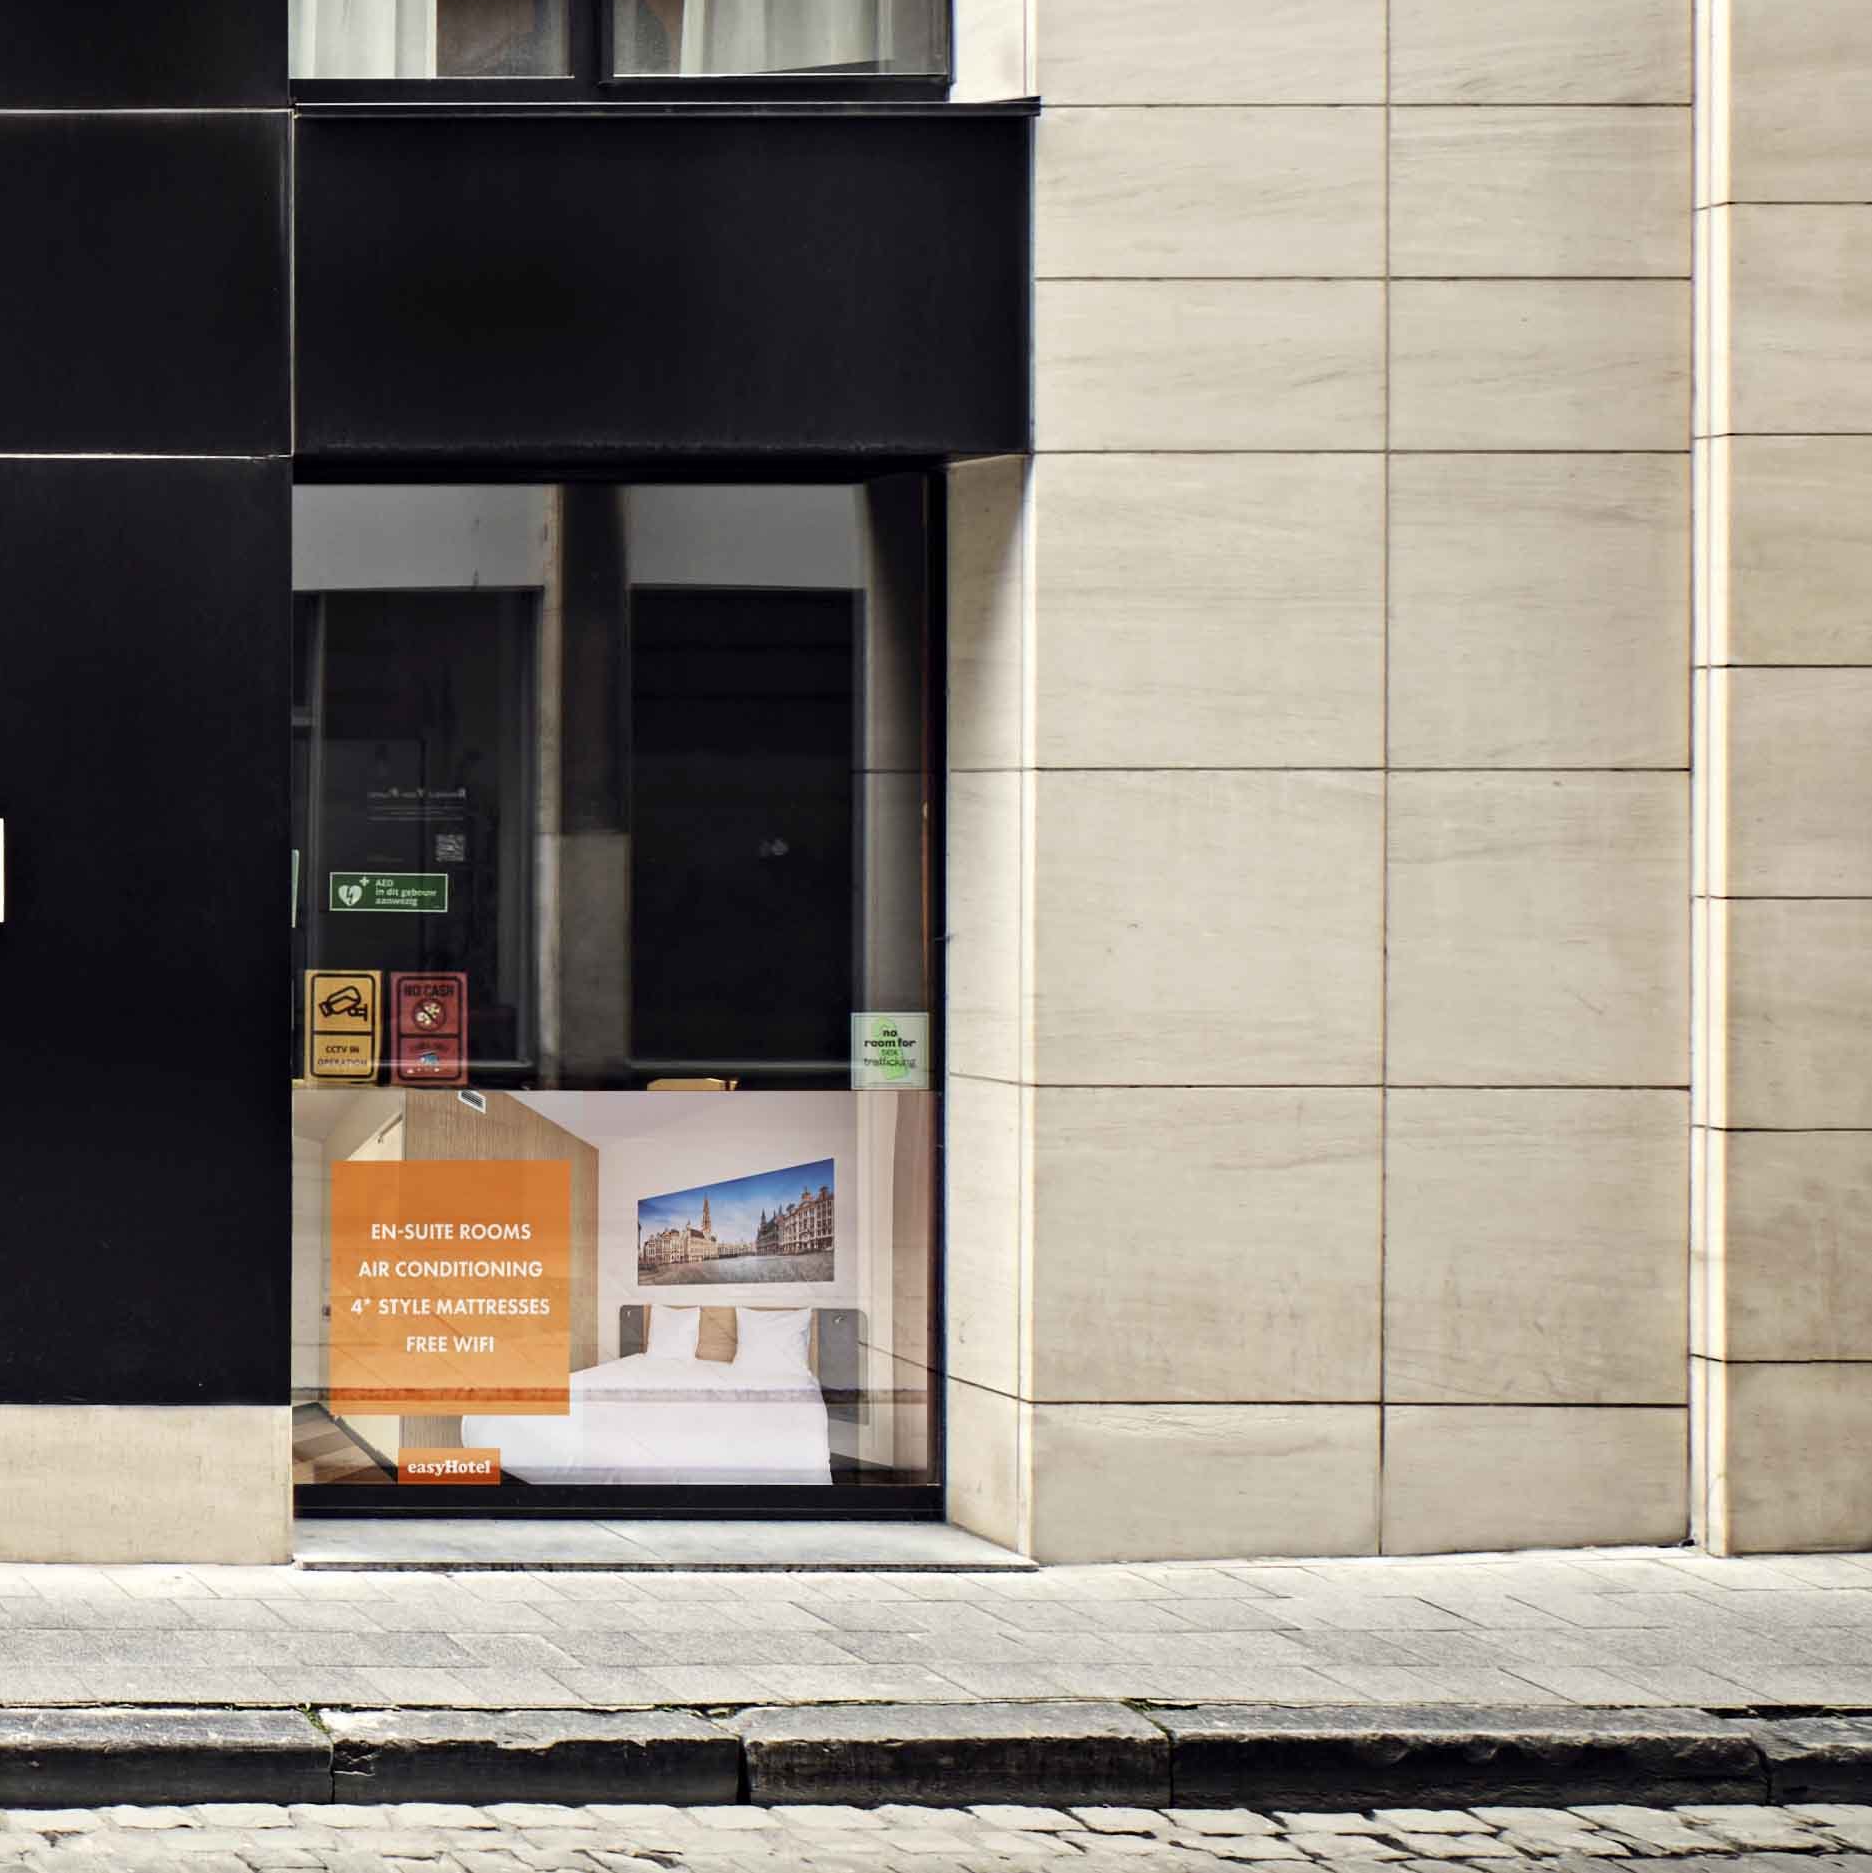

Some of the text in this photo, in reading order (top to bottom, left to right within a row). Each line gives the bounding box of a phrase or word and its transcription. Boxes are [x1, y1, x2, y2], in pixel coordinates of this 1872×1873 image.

[864, 1037, 917, 1048] room for
[882, 1029, 898, 1038] no
[370, 1223, 532, 1240] EN-SUITE ROOMS
[358, 1260, 543, 1278] AIR CONDITIONING
[378, 1298, 431, 1316] STYLE
[436, 1298, 551, 1316] MATTRESSES
[406, 1335, 495, 1353] FREE WIFI
[406, 1459, 492, 1477] easyHotel
